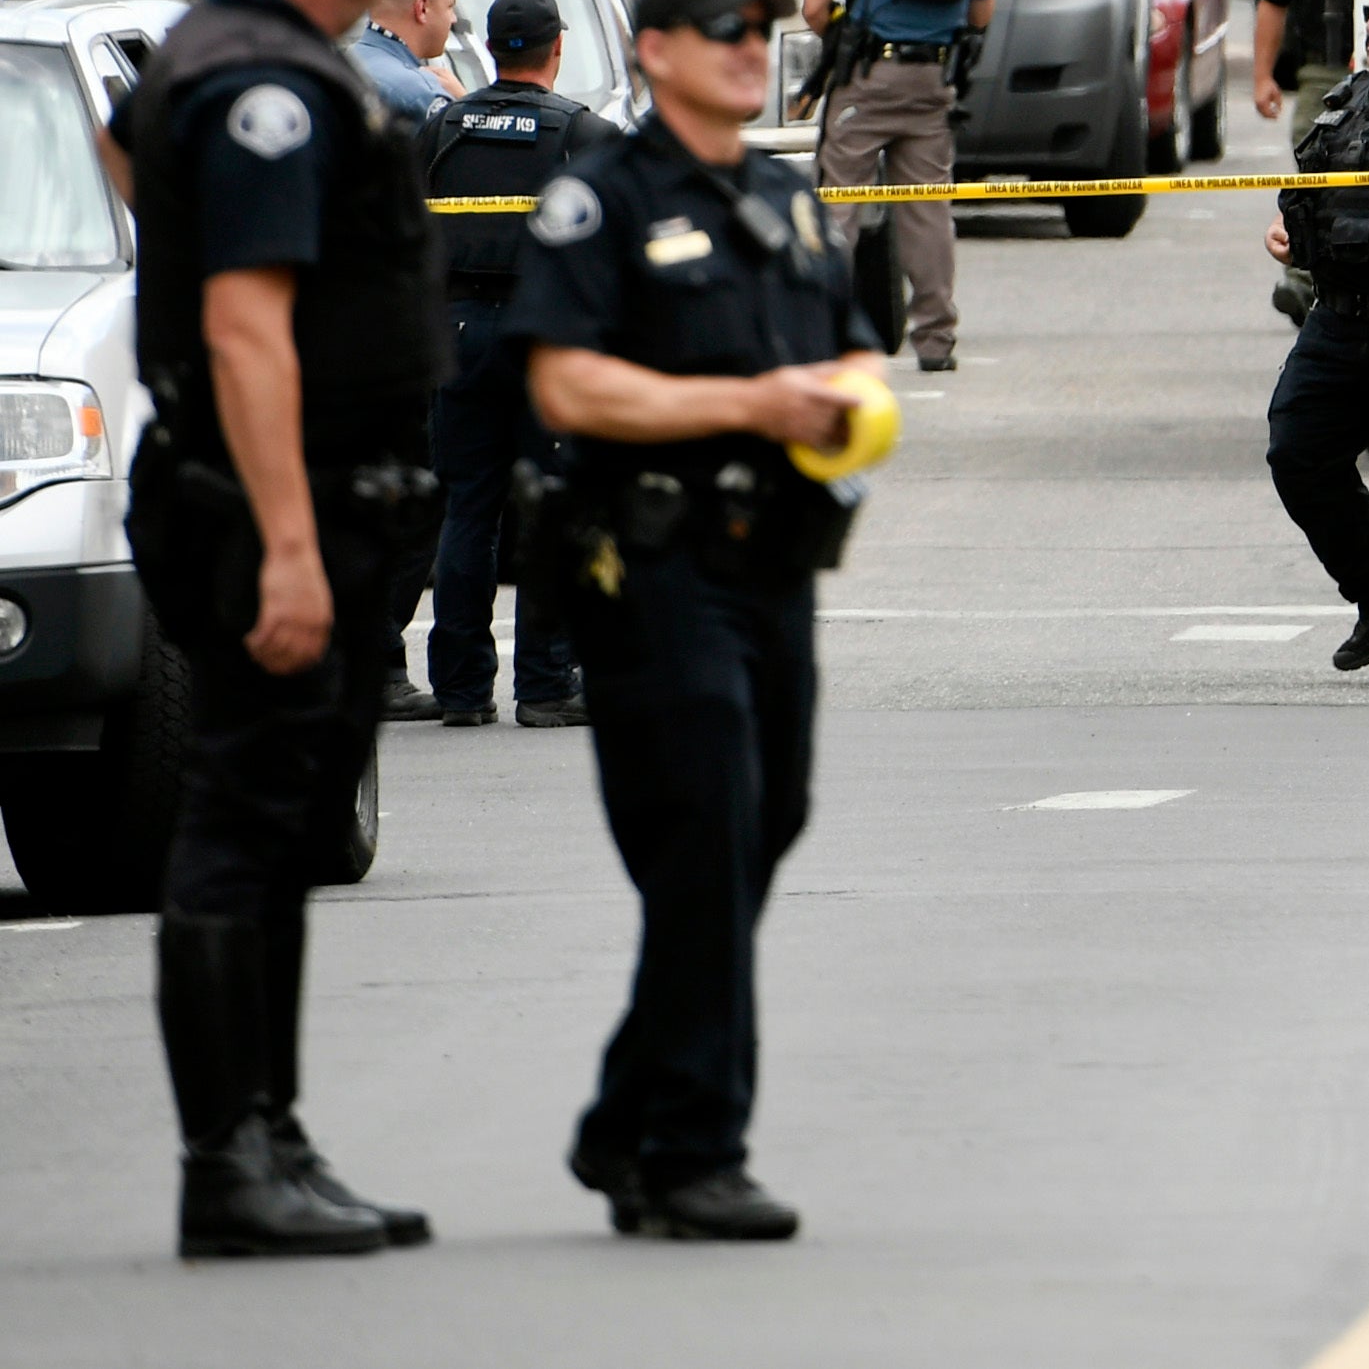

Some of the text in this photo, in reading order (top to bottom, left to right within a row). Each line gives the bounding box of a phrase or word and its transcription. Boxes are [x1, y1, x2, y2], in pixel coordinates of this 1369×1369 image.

[462, 114, 536, 133] SHERIFF K9
[985, 182, 1007, 193] LINEA
[1022, 181, 1052, 192] POLICIA
[1072, 180, 1097, 191] FAVOR
[1112, 178, 1143, 190] CRUZAR
[1169, 175, 1328, 189] LINEA DE POLICIA POR FAVOR NO CRUZAR
